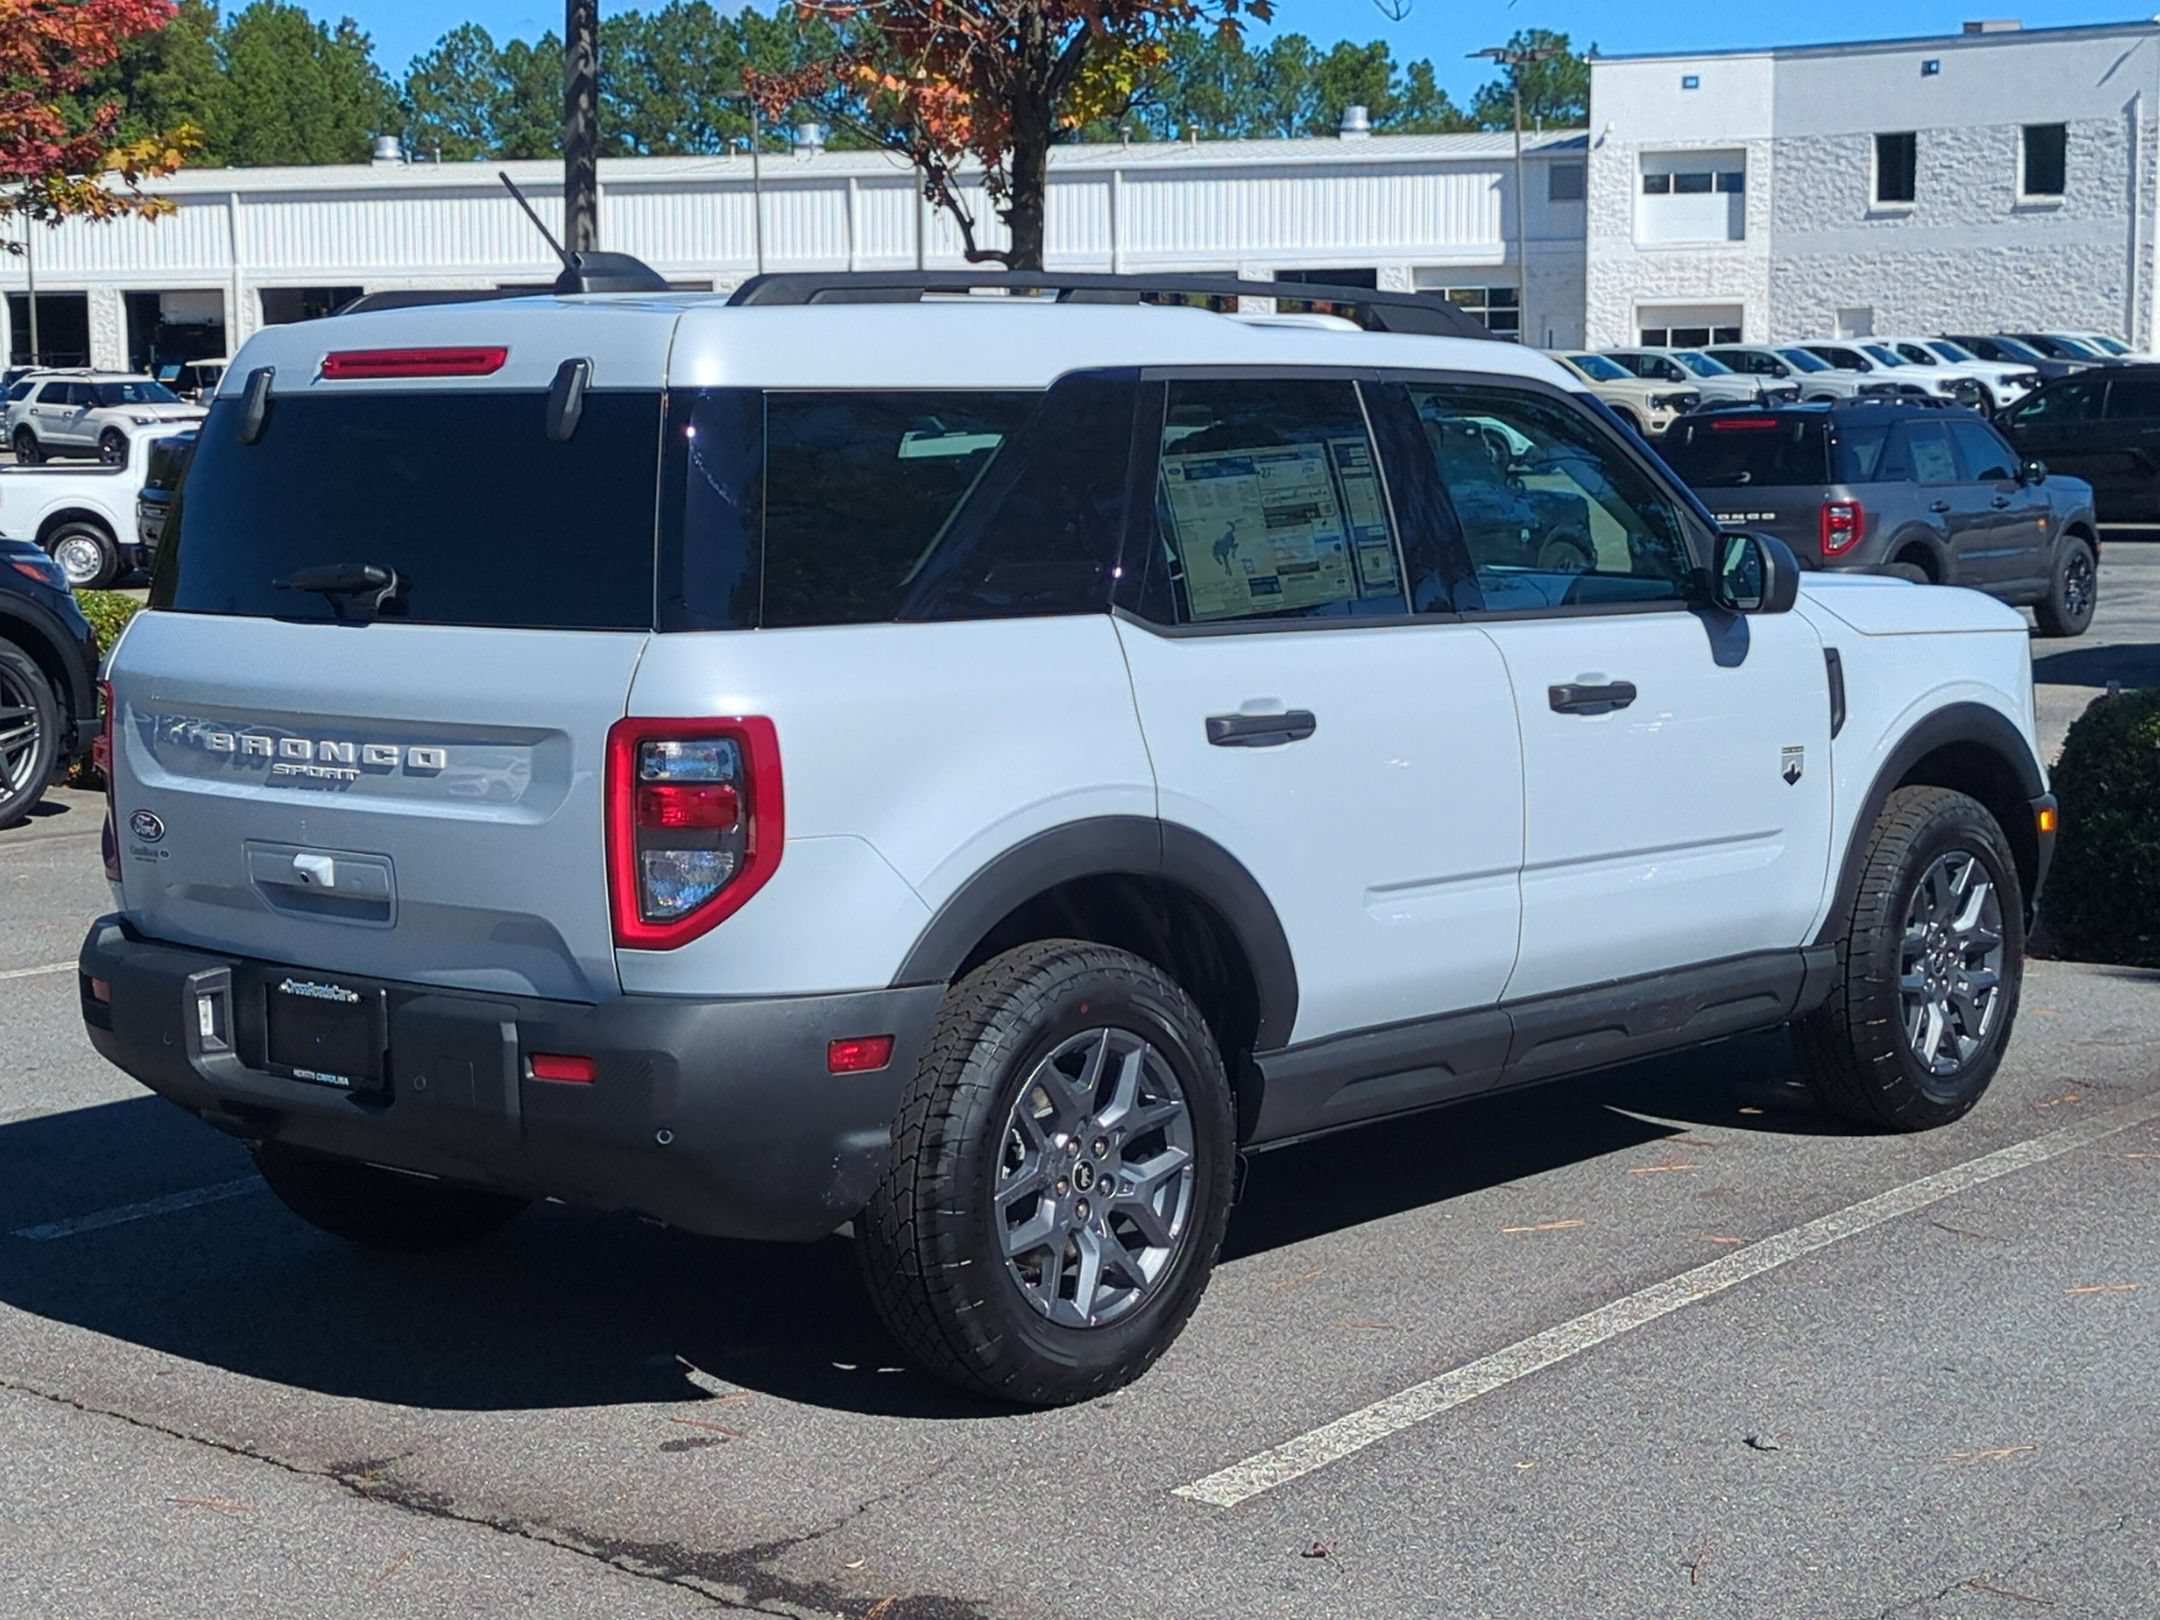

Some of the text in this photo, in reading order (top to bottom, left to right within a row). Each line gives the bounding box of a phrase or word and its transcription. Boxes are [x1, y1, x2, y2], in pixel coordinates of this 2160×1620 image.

[206, 732, 447, 770] BRONCO
[271, 762, 361, 781] SPORT
[293, 1067, 316, 1081] NORTH
